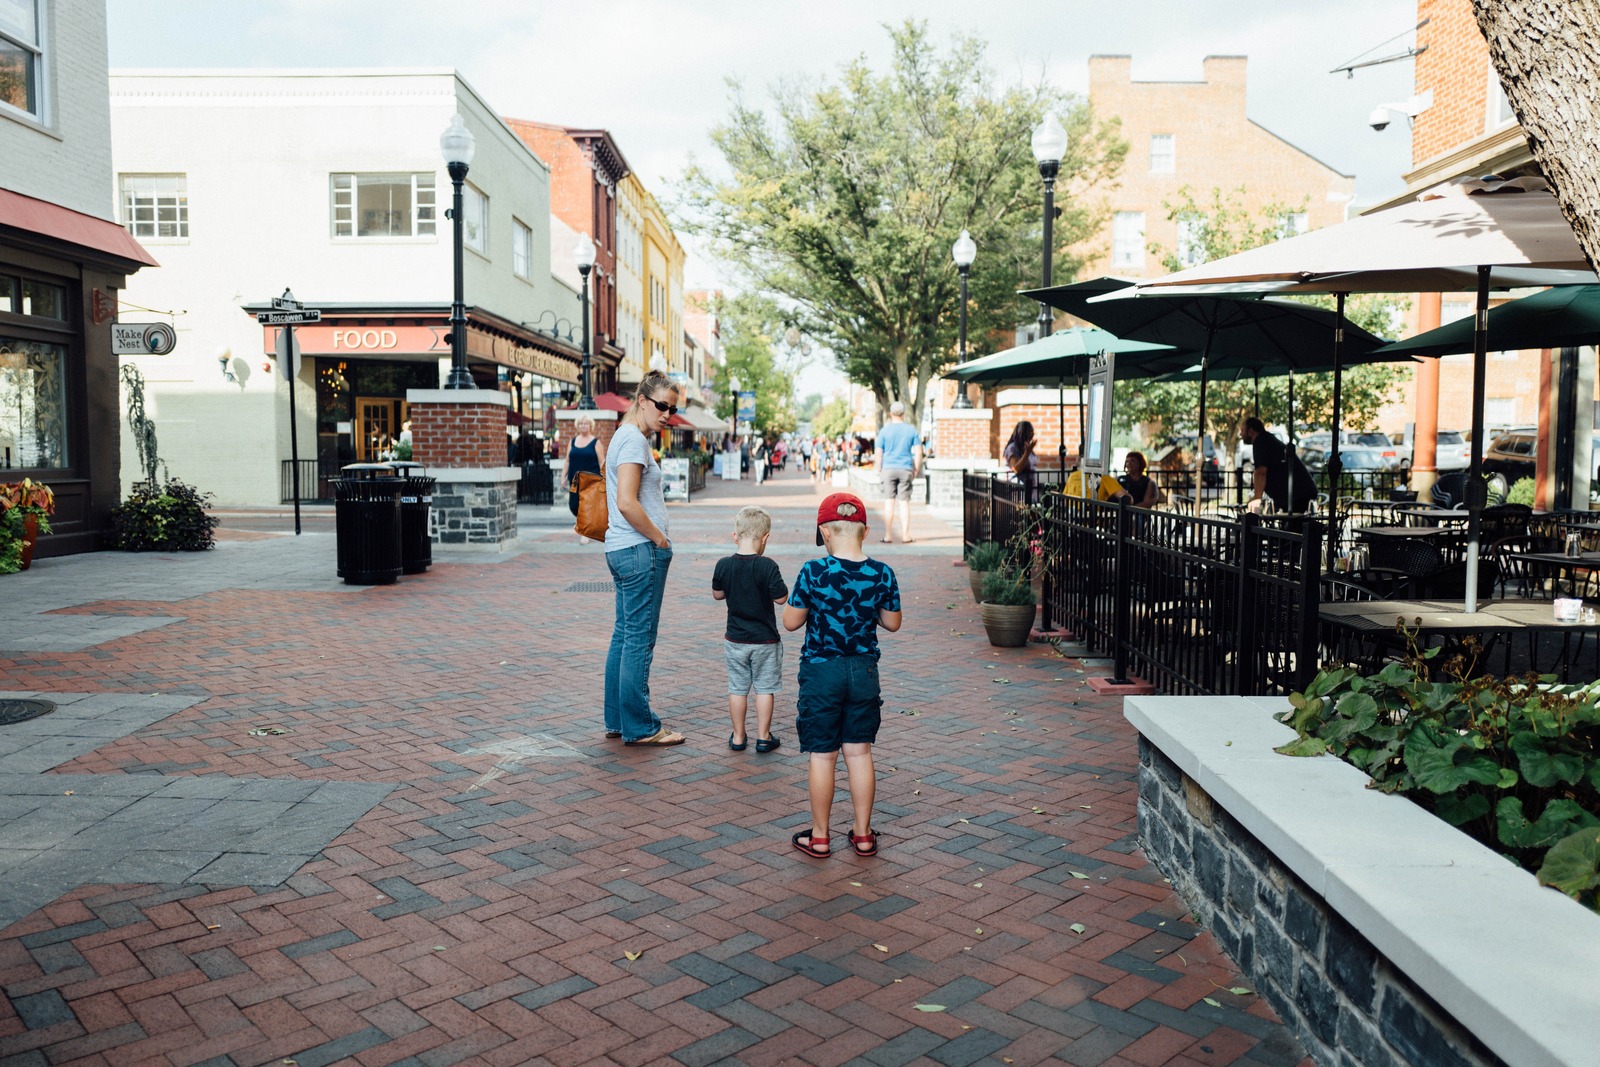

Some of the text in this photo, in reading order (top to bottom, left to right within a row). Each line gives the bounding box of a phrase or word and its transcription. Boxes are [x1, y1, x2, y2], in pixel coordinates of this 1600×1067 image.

[269, 314, 303, 322] Boscawen
[116, 329, 142, 339] Make
[333, 329, 398, 349] FOOD
[118, 339, 141, 349] Nest
